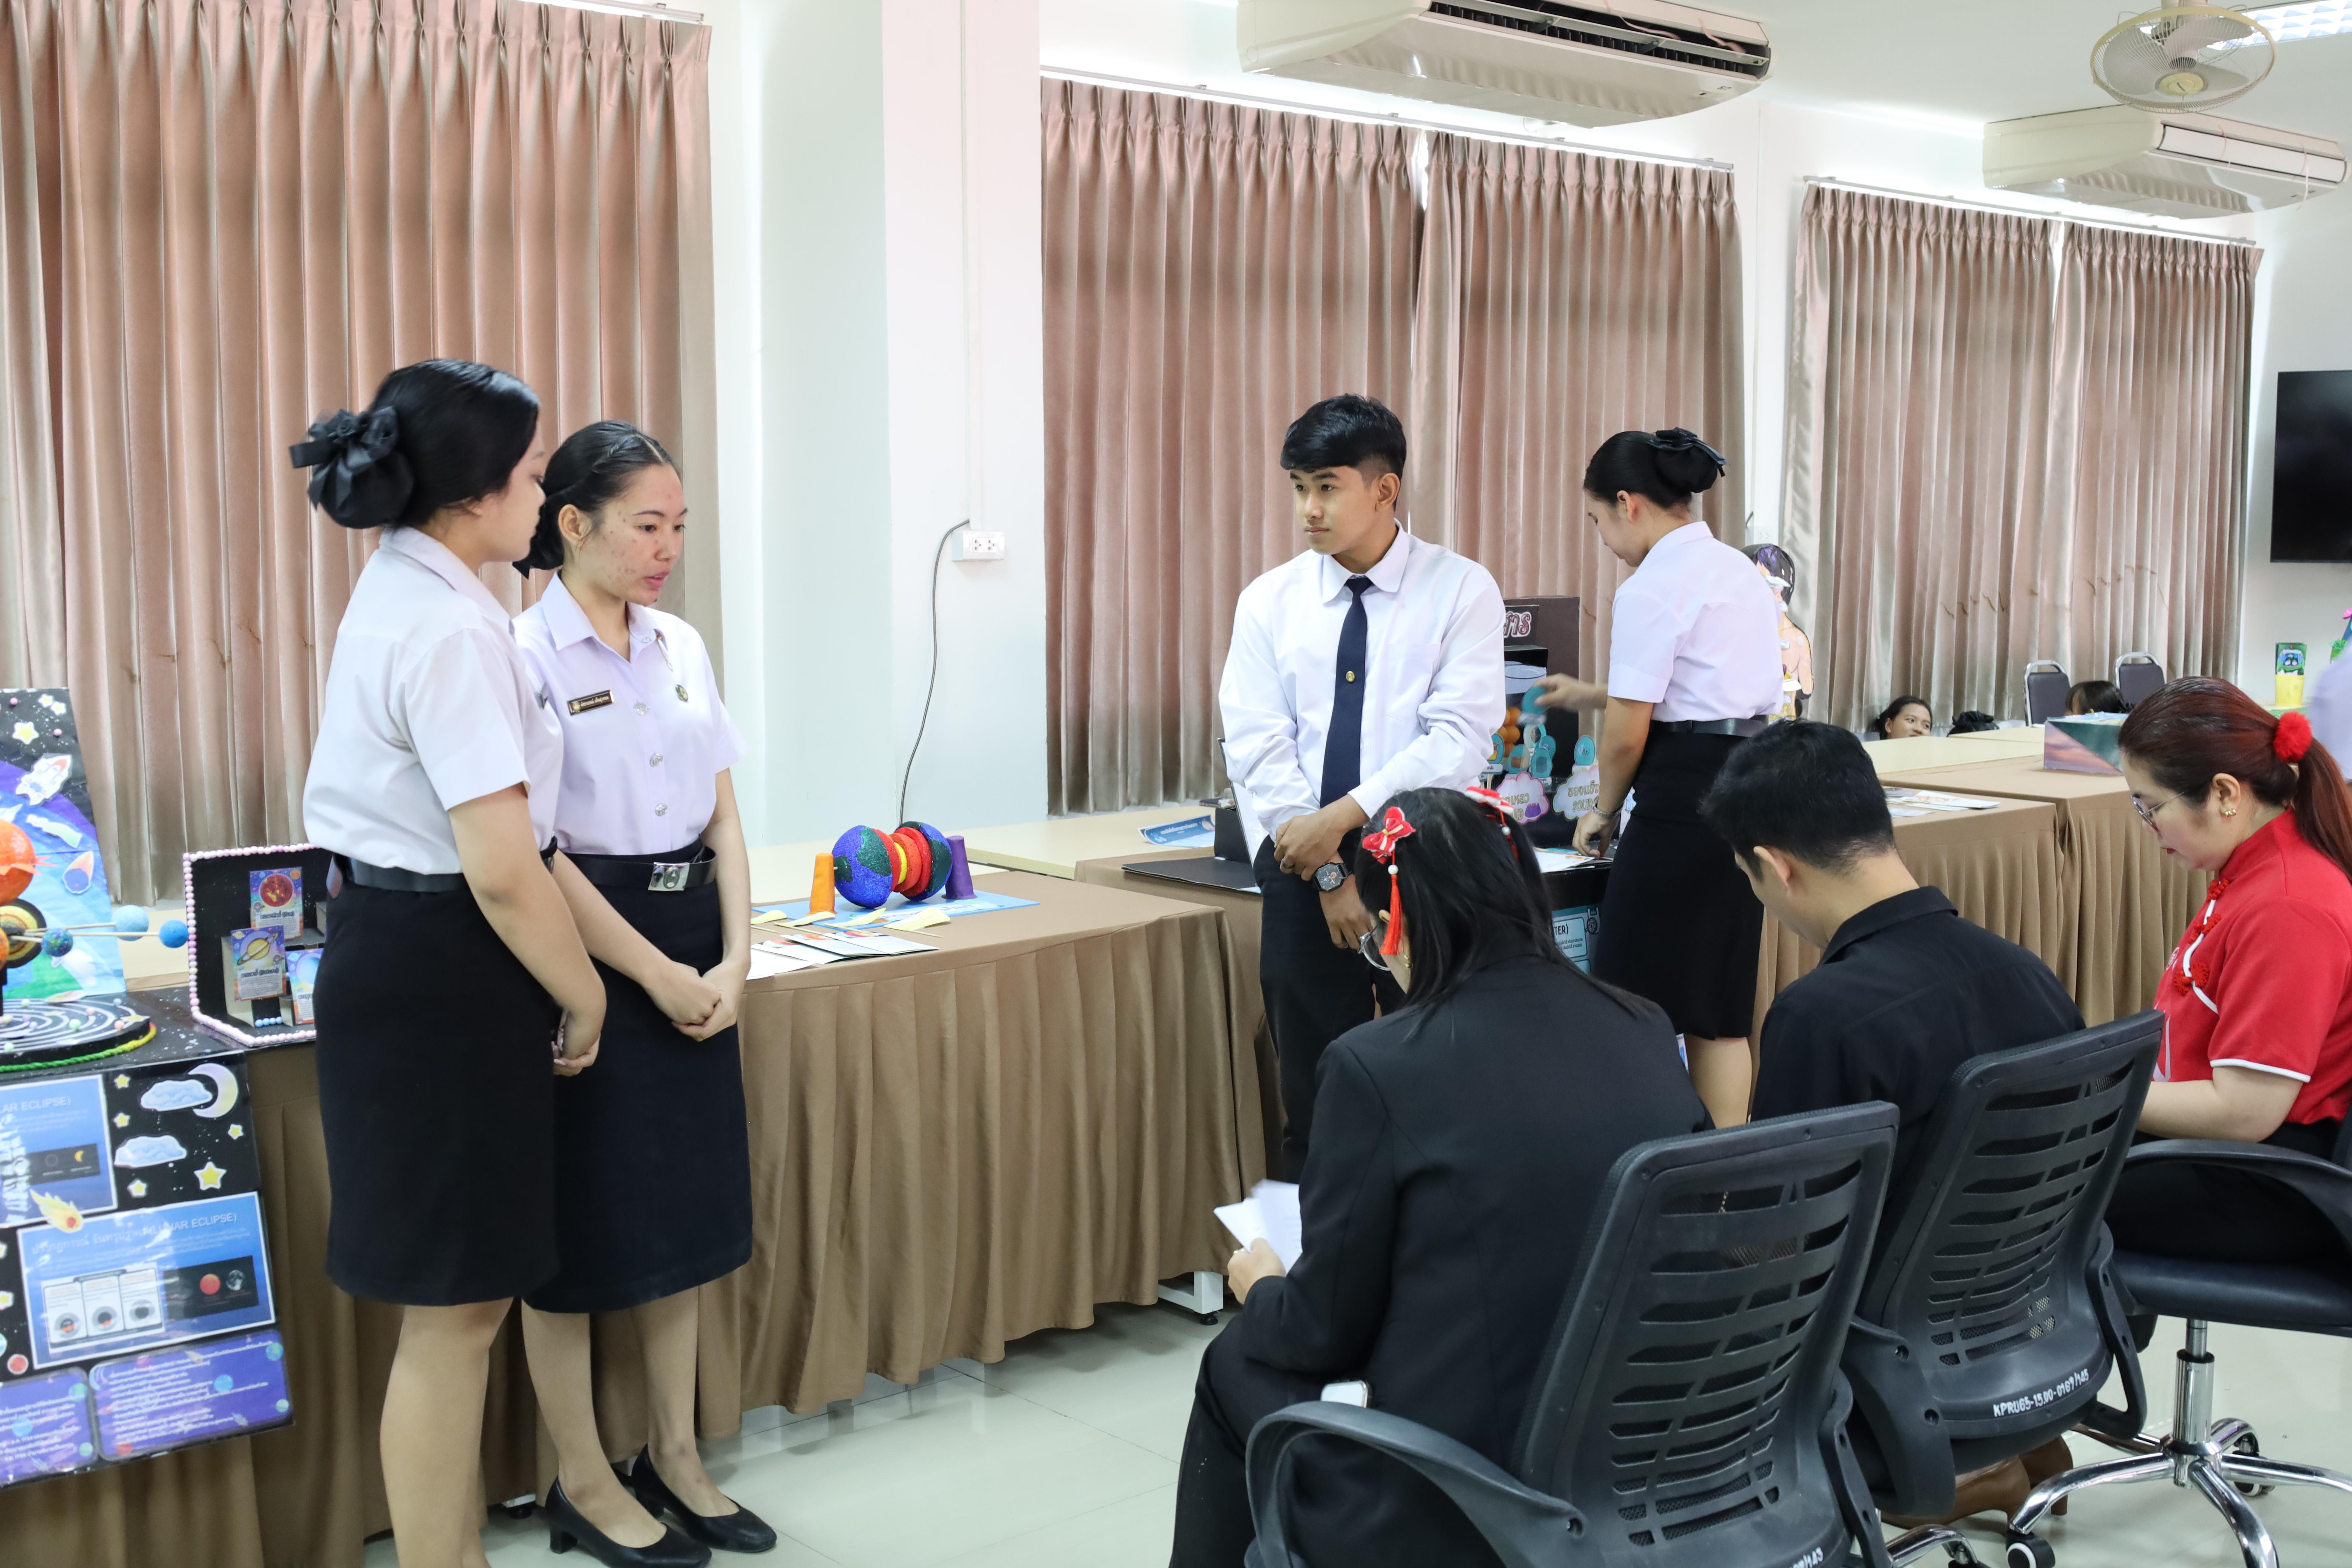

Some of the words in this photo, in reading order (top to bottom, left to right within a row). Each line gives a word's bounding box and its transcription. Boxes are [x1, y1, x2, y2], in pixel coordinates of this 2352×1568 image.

[1568, 780, 1600, 797] ของแข็ง
[1573, 798, 1593, 812] SOLID
[1554, 923, 1568, 936] TER)
[21, 1095, 71, 1111] ECLIPSE)
[191, 1212, 237, 1228] ECLIPSE)
